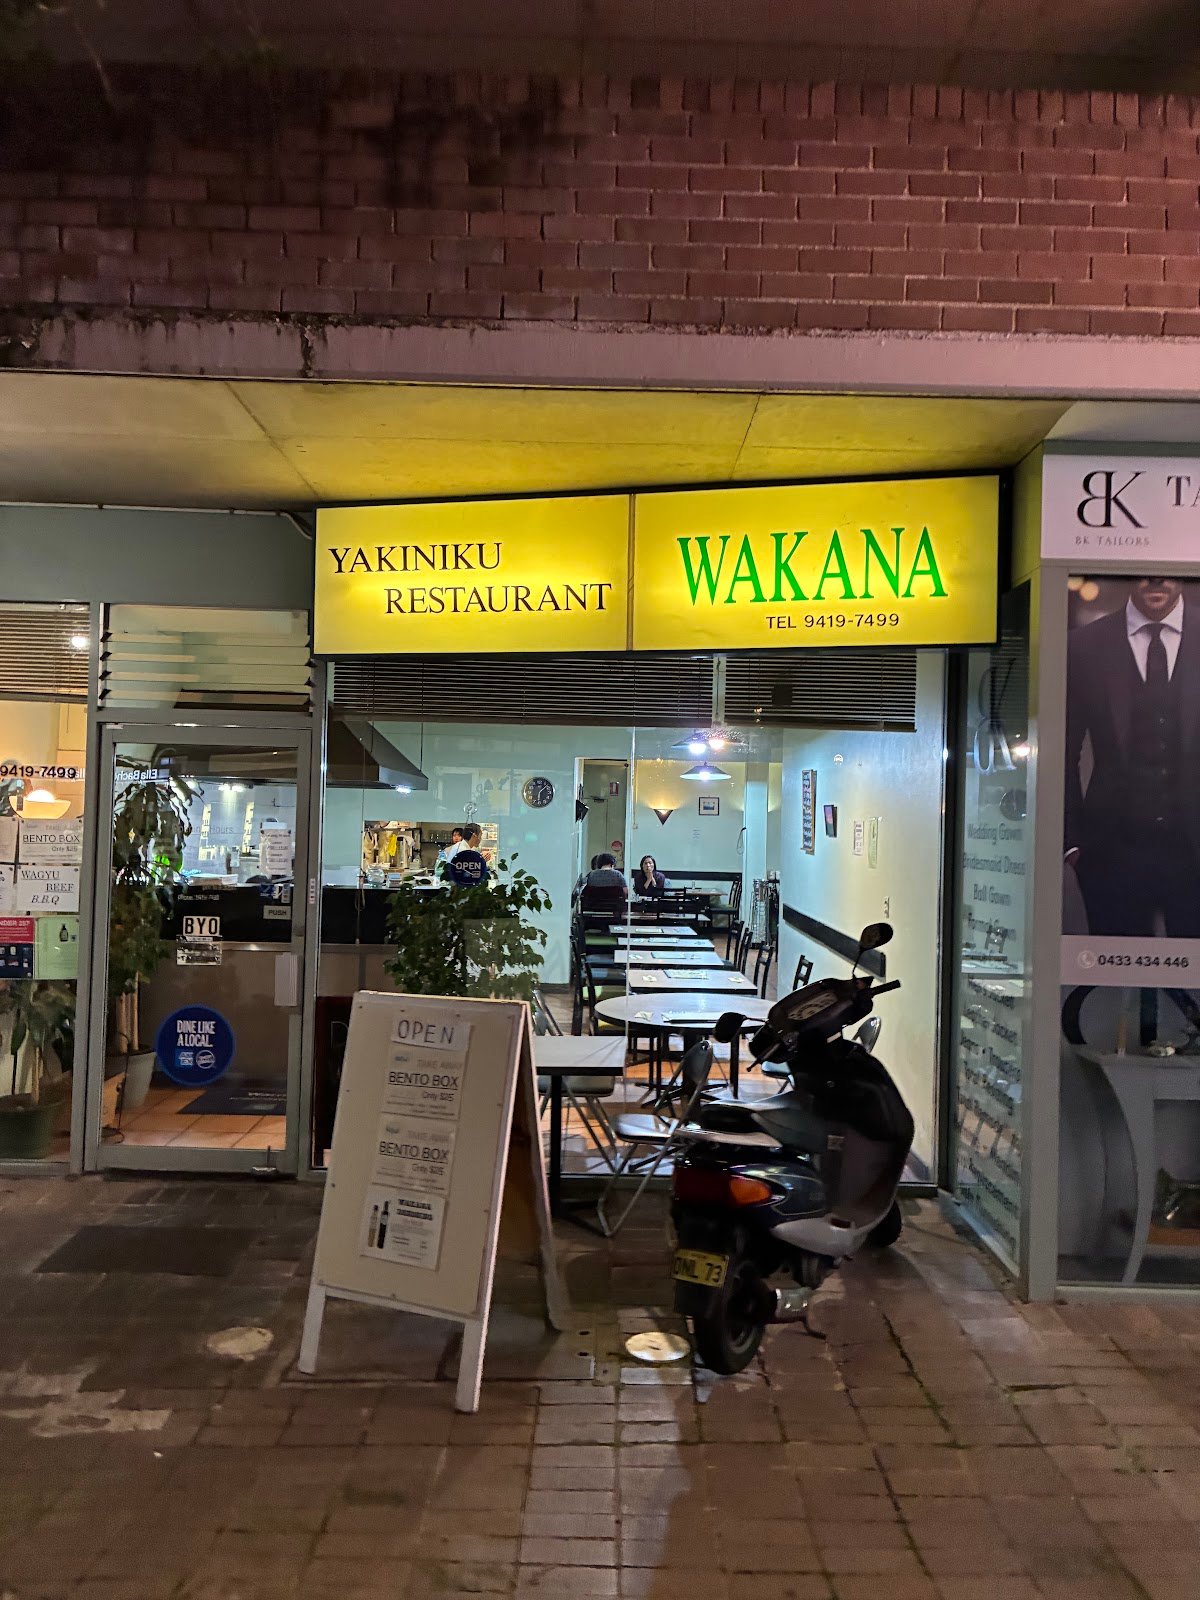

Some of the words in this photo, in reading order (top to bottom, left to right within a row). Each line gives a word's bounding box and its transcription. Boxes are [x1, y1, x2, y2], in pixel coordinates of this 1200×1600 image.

[1075, 536, 1090, 545] BK
[1097, 536, 1151, 546] TAILORS
[328, 542, 504, 574] YAKINIKU
[677, 526, 949, 606] WAKANA
[384, 583, 612, 614] RESTAURANT
[766, 616, 797, 629] TEL
[804, 613, 900, 629] 9419-7499
[0, 765, 77, 779] 9419-7499
[22, 834, 57, 843] BENTO
[59, 834, 80, 843] BOX
[456, 861, 481, 870] OPEN
[21, 870, 60, 880] WAGYU
[45, 883, 75, 893] BEEF
[185, 917, 218, 935] BYO
[1098, 955, 1131, 967] 0433
[1135, 956, 1160, 968] 434
[176, 1020, 197, 1034] DINE
[198, 1021, 216, 1035] LIKE
[397, 1019, 454, 1044] OPEN
[177, 1034, 185, 1047] A
[185, 1034, 213, 1048] LOCAL.
[388, 1071, 430, 1086] BENTO
[432, 1075, 458, 1088] BOX
[379, 1141, 420, 1157] BENTO
[422, 1147, 449, 1160] BOX
[705, 1262, 723, 1282] 73
